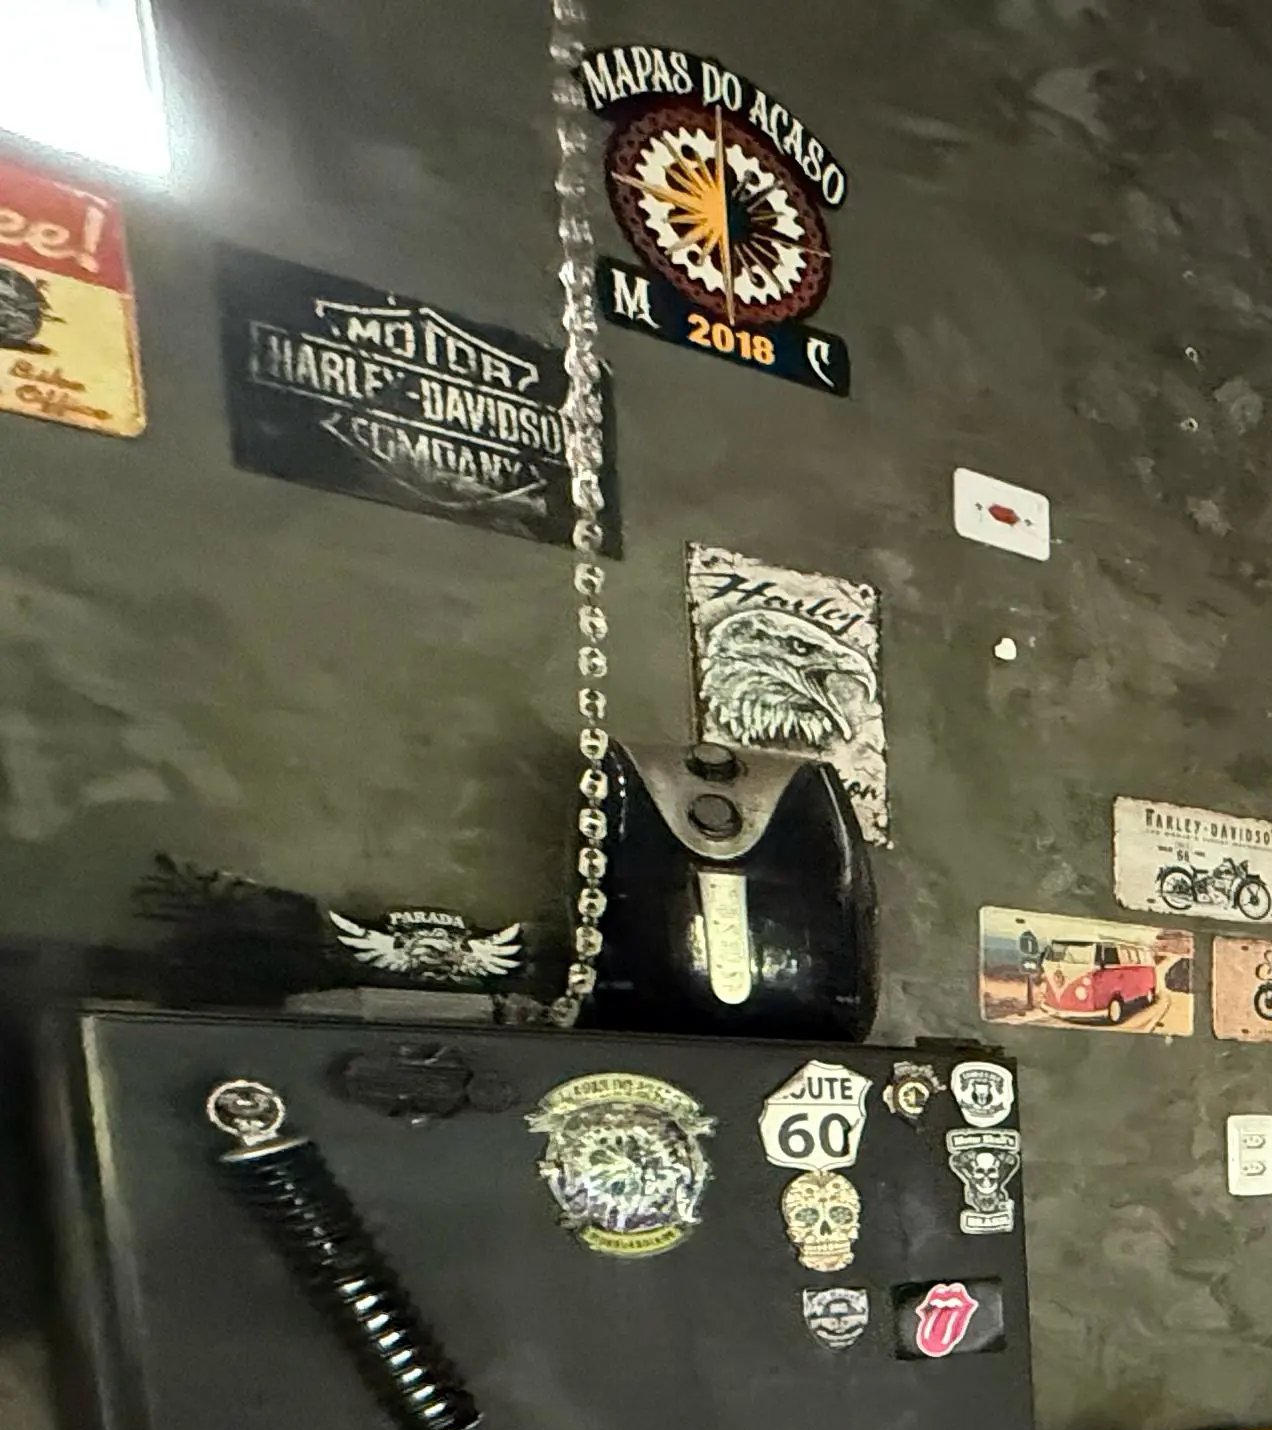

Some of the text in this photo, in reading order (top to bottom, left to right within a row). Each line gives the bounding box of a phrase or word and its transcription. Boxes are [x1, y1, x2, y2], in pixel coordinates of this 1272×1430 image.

[582, 45, 845, 205] MAPAS DO ACASO
[611, 268, 662, 329] M
[687, 313, 775, 366] 2018
[346, 317, 513, 390] MOTOR
[266, 333, 566, 456] HARLEY-DAVIDSO
[350, 416, 525, 487] COMPANY
[388, 910, 466, 929] PARADA
[786, 1076, 854, 1101] UTE
[777, 1112, 852, 1159] 60
